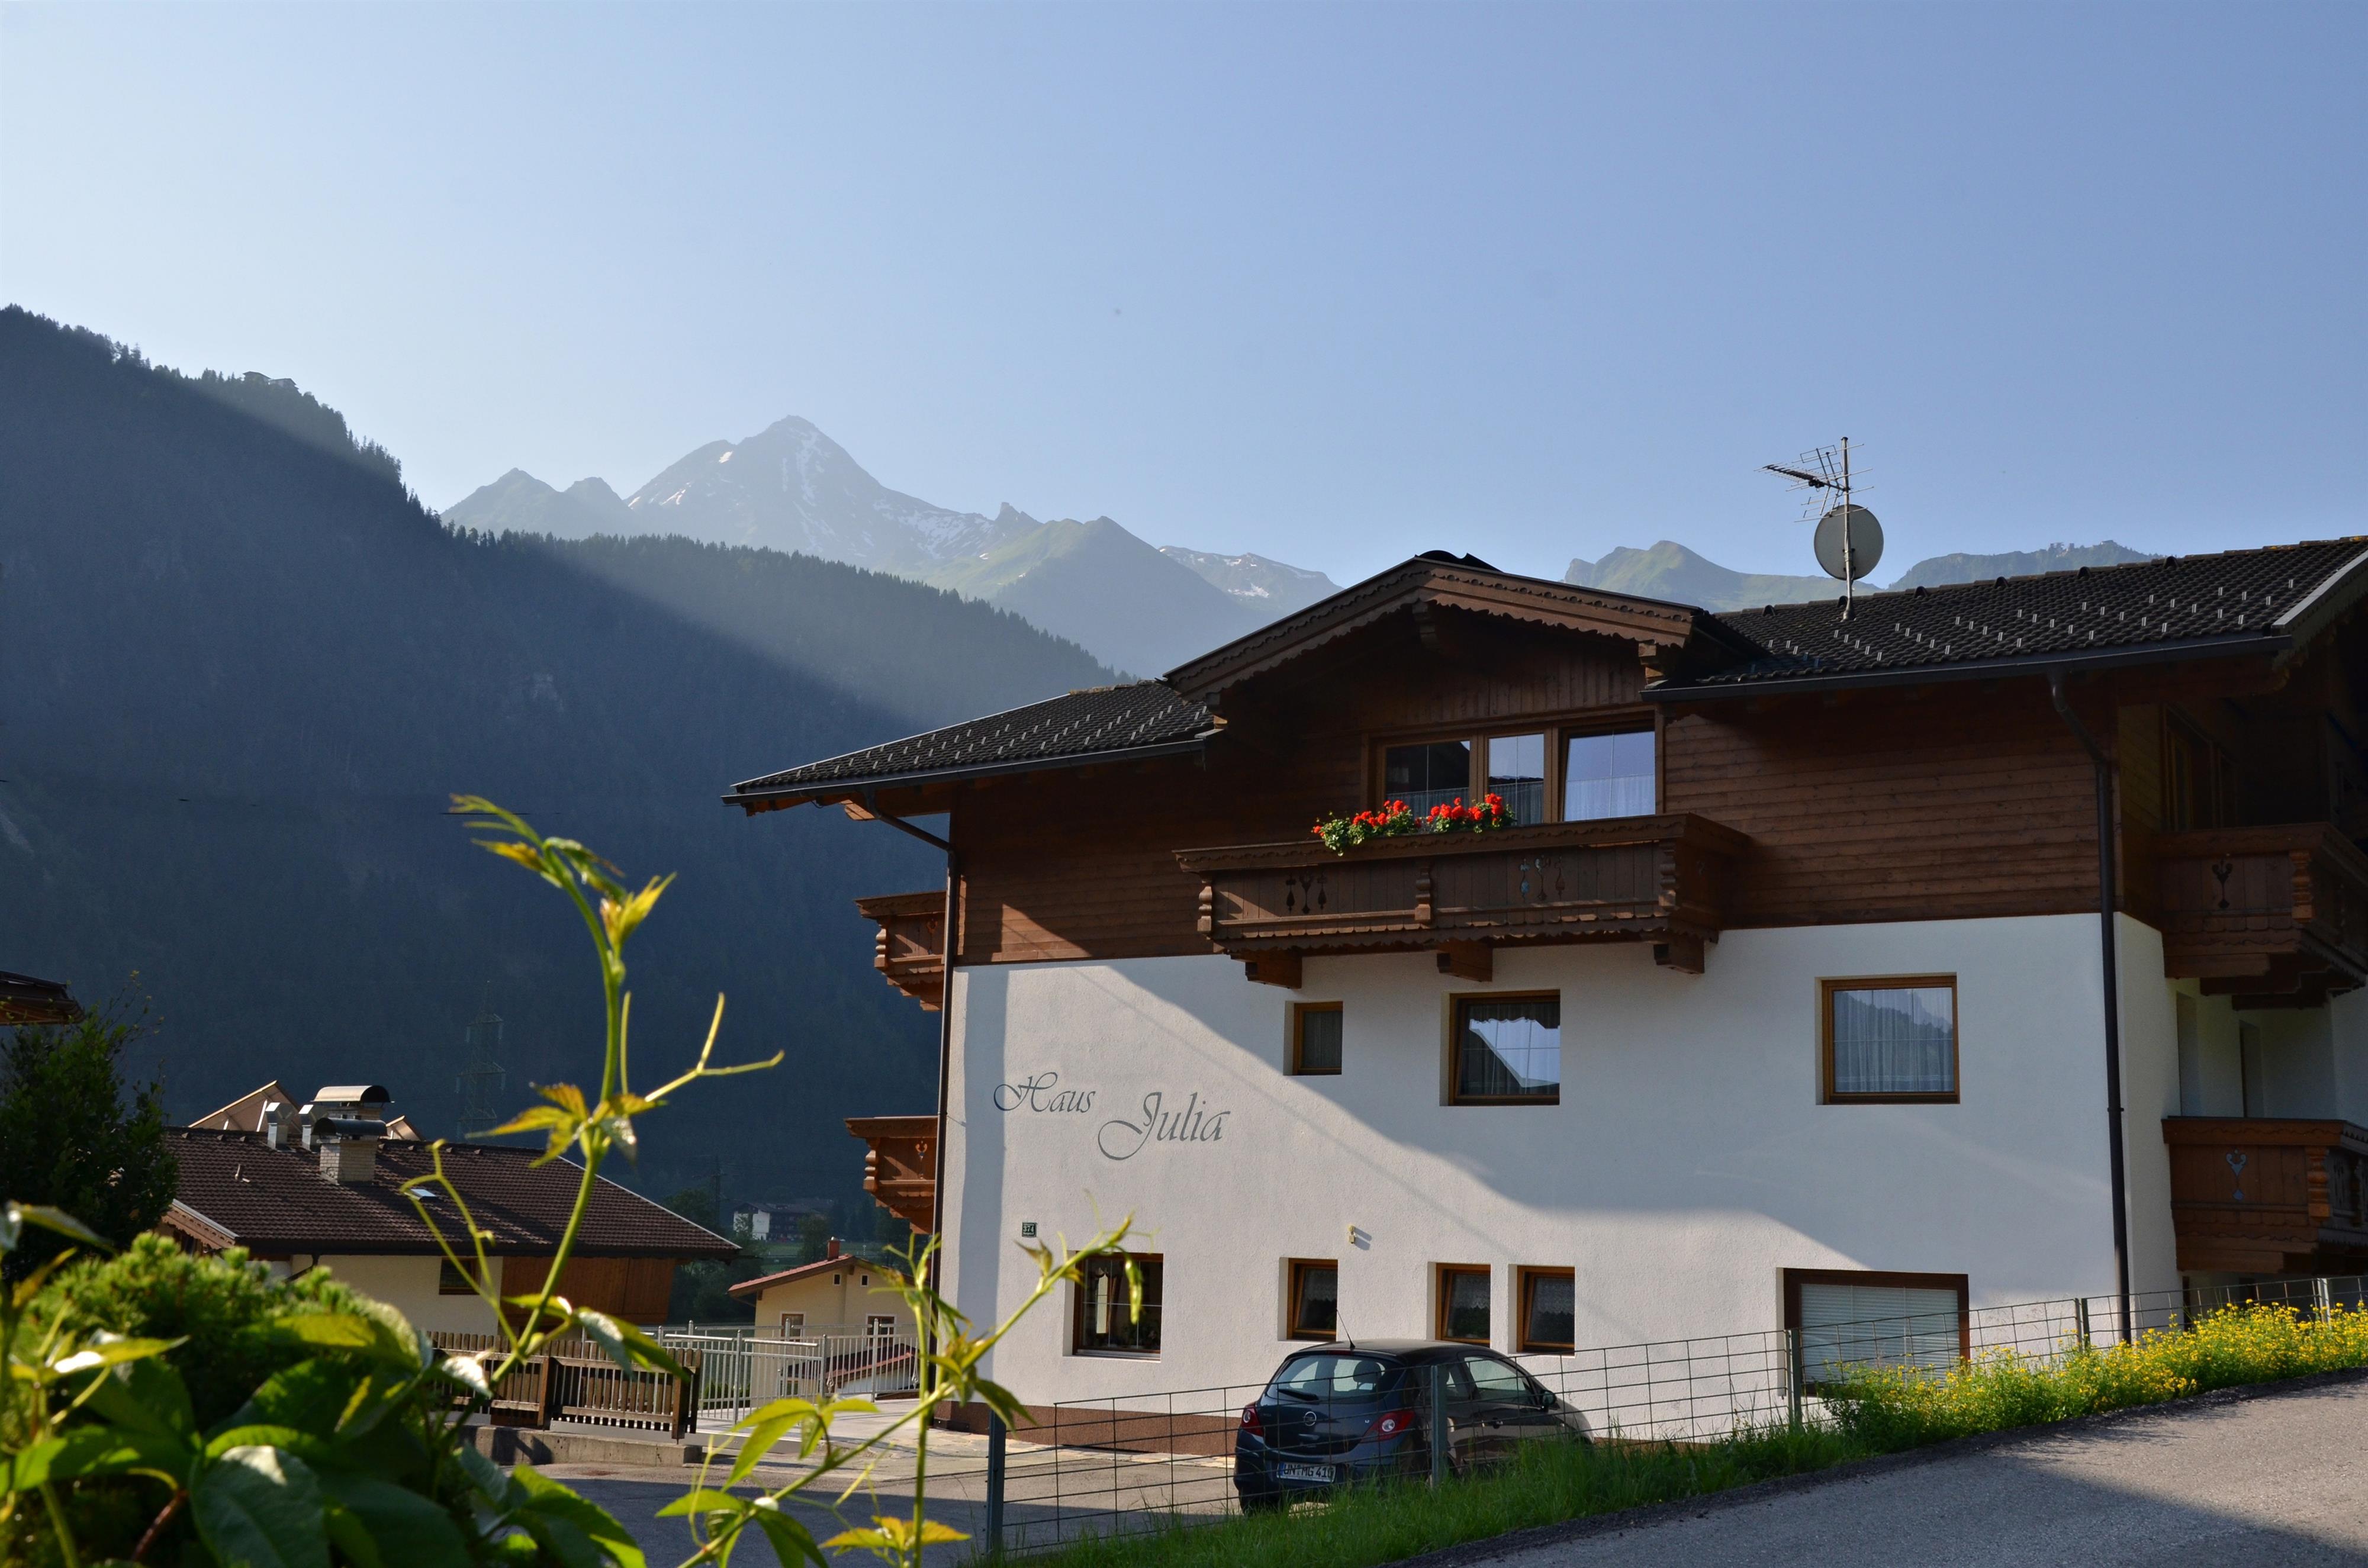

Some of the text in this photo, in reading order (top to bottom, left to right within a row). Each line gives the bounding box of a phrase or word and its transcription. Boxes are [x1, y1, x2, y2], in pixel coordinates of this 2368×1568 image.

[993, 1072, 1231, 1160] Haus Julia
[1301, 1466, 1314, 1477] MG
